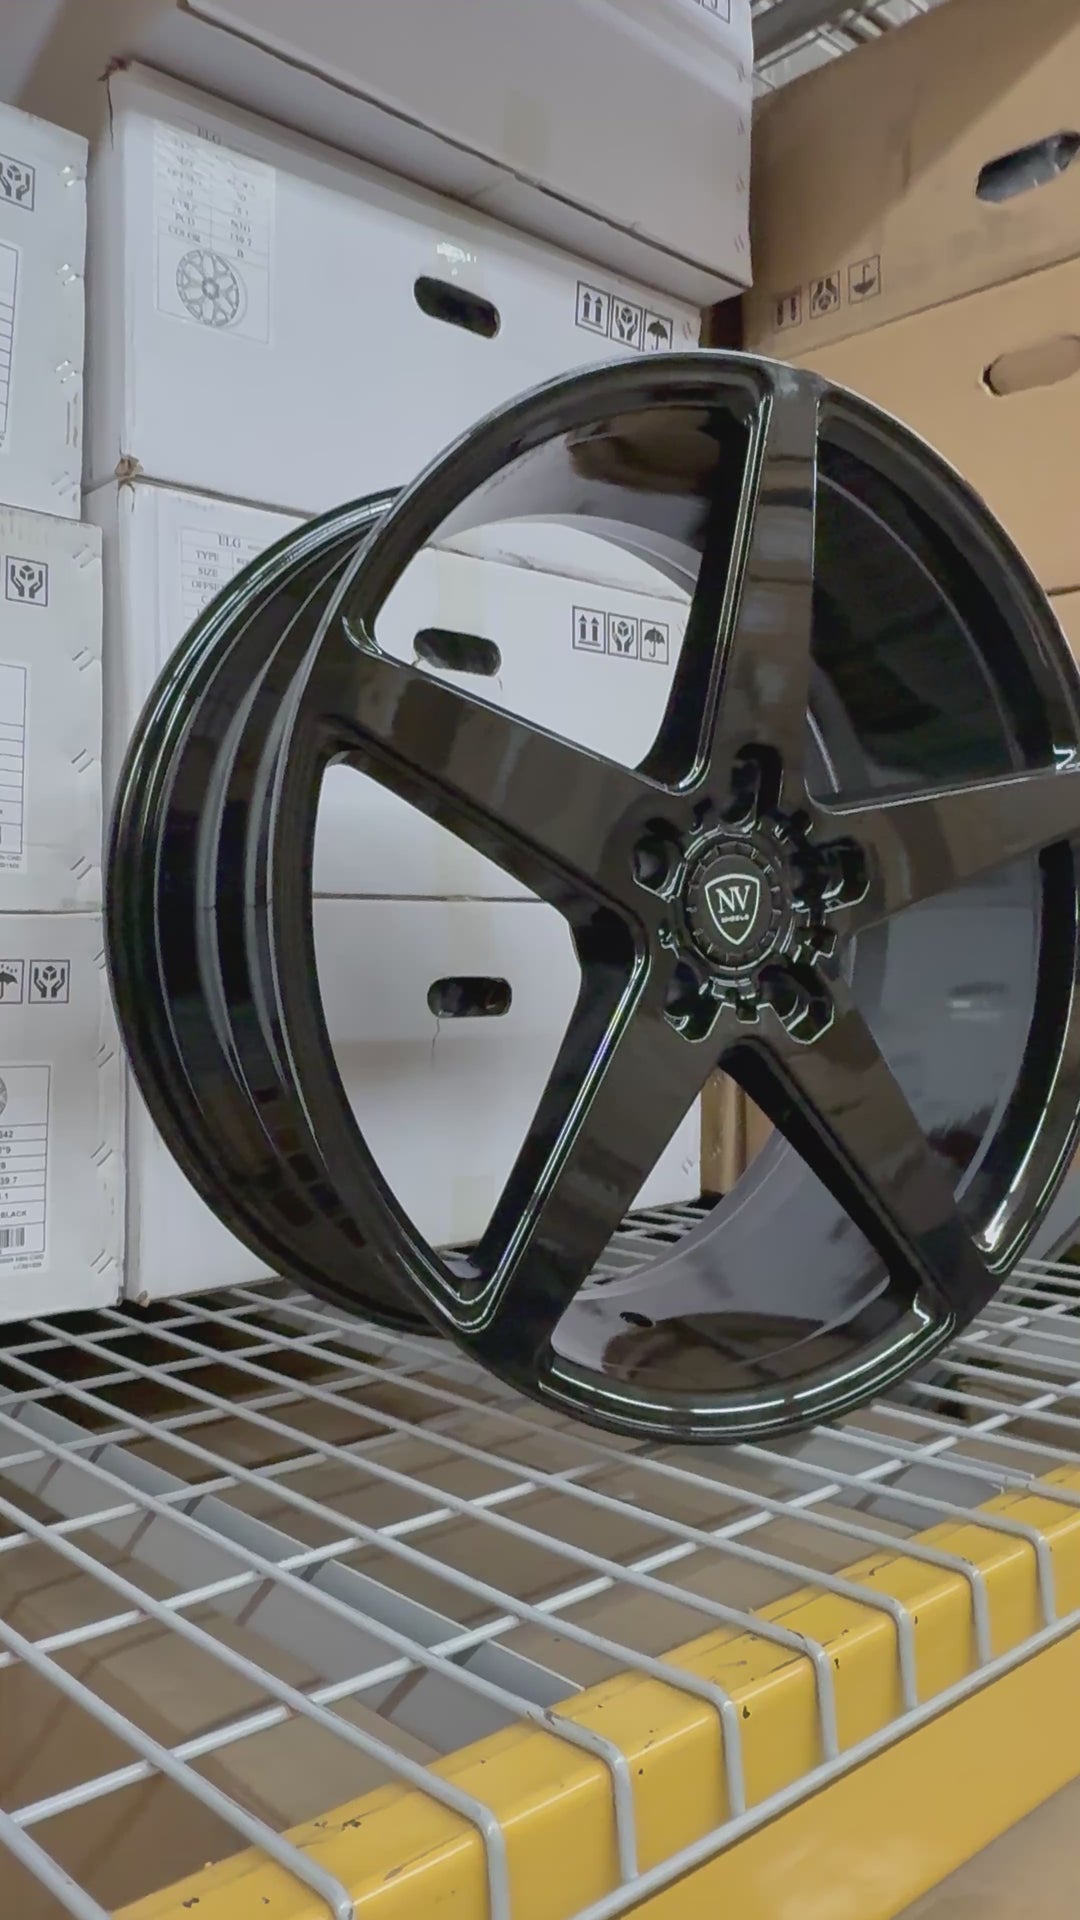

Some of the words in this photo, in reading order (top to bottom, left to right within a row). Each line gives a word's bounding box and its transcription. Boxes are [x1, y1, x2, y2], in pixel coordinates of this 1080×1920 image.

[217, 533, 241, 549] ELG
[196, 550, 220, 561] TYPE
[198, 567, 219, 577] SIZE
[715, 884, 751, 914] NV
[0, 1210, 27, 1219] BLACK
